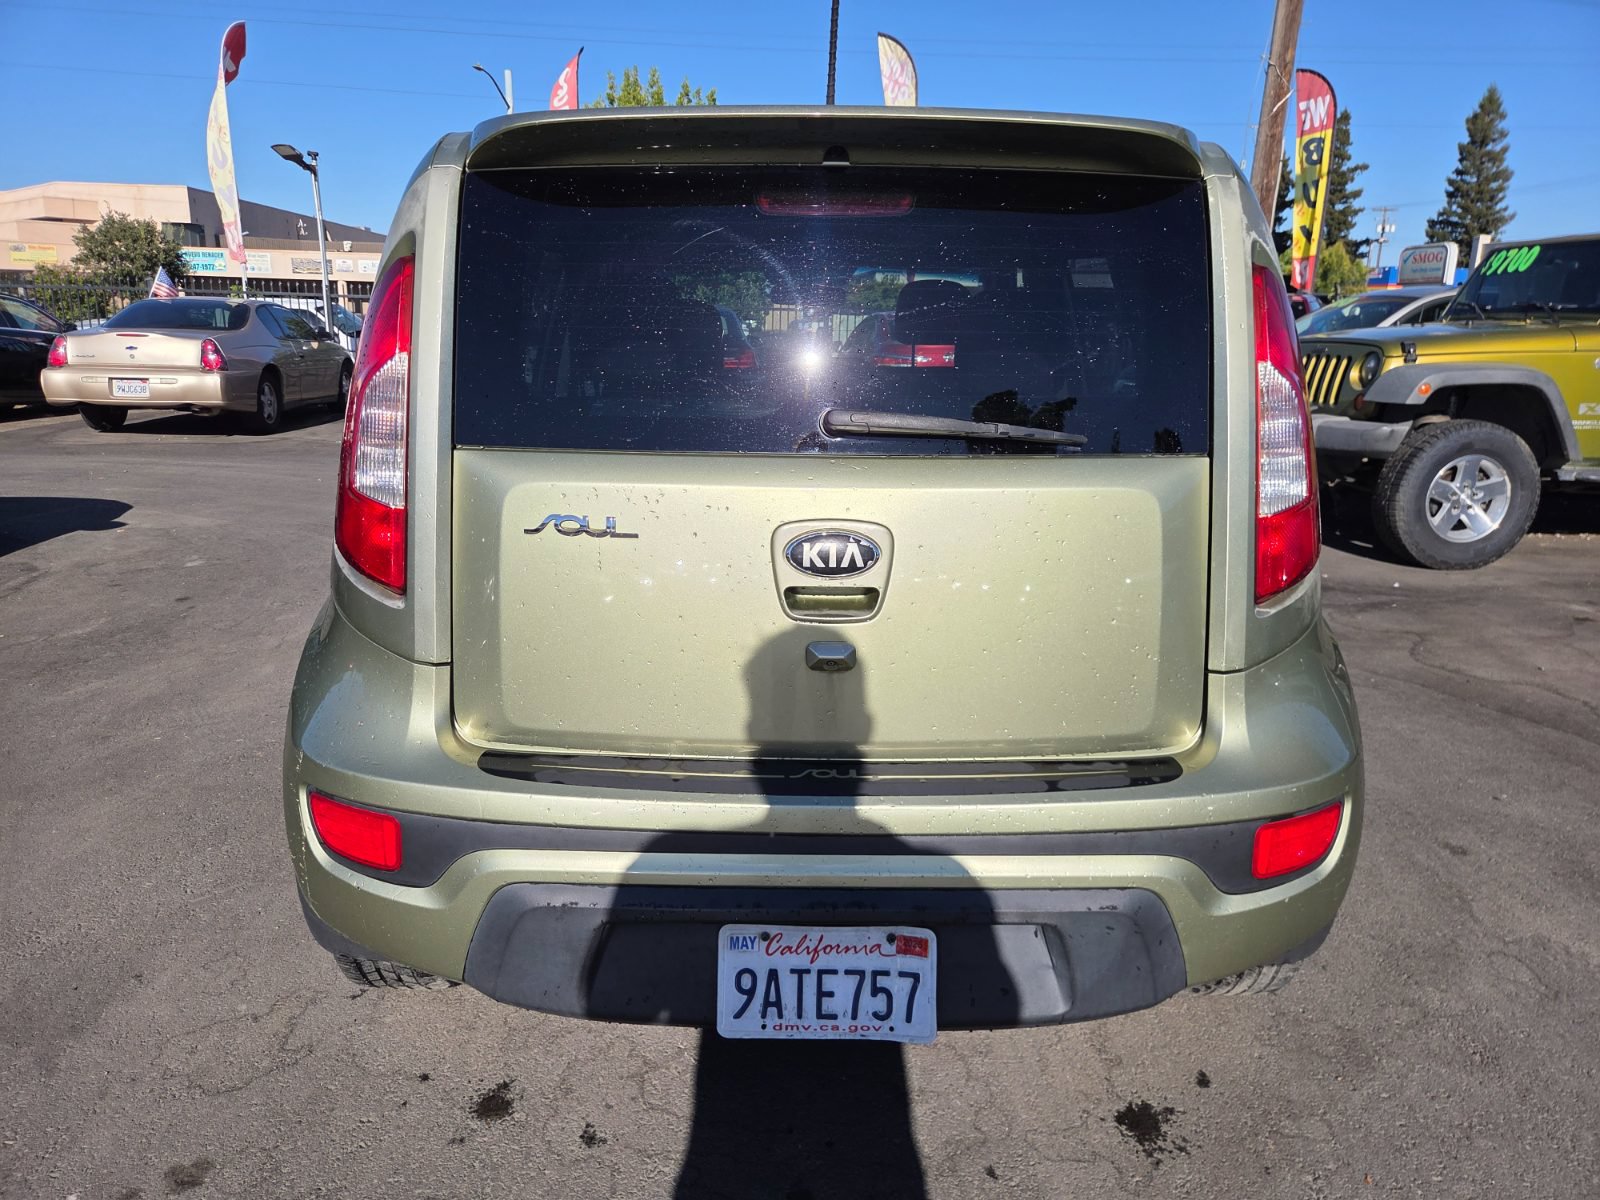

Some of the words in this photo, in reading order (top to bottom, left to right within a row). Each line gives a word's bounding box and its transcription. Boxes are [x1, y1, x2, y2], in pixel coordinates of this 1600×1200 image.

[1412, 251, 1443, 264] SMOG
[523, 513, 639, 539] SOUL
[801, 542, 865, 568] KIA
[729, 935, 757, 950] MAY
[764, 932, 897, 964] California
[732, 967, 921, 1024] 9ATE757
[772, 1022, 882, 1034] dmv.ca.gov
